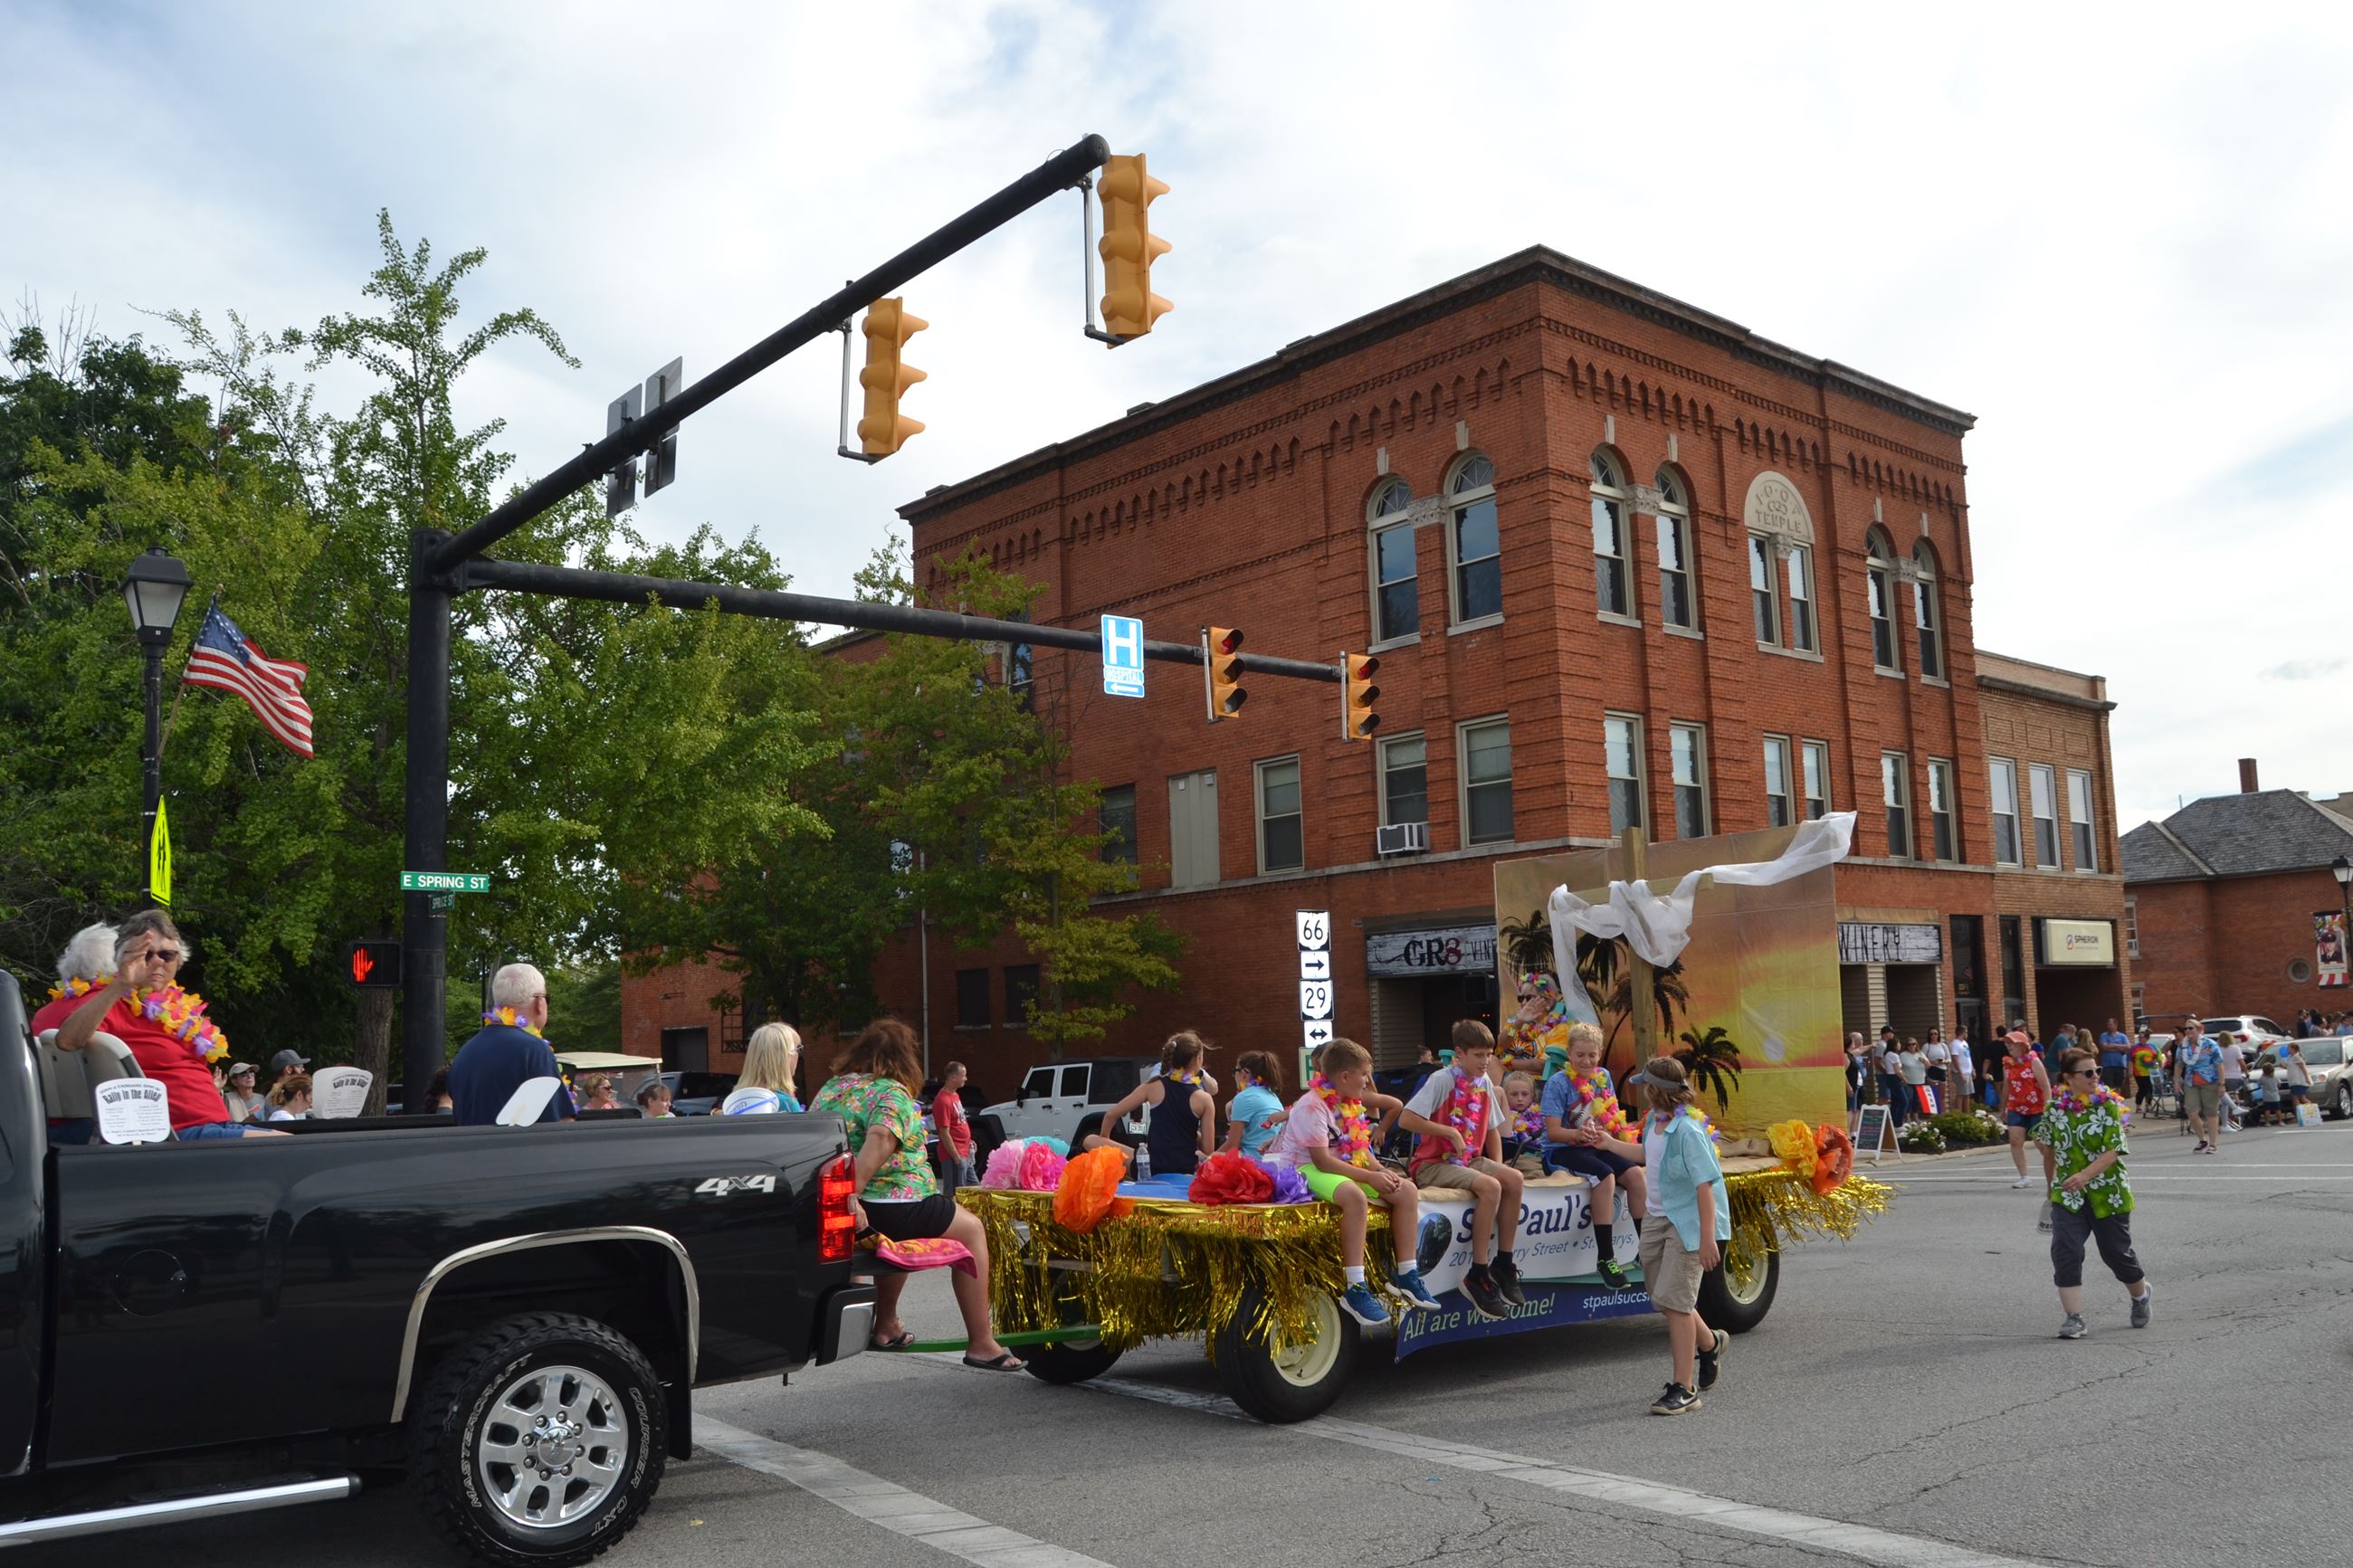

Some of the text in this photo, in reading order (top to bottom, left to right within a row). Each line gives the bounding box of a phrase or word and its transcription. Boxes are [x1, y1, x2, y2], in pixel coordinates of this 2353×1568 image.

[1755, 509, 1802, 534] TEMPLE
[1108, 619, 1138, 667] H
[403, 874, 486, 889] E SPRING ST
[1303, 919, 1323, 940] 66
[1404, 937, 1462, 966] GR8
[1837, 925, 1902, 962] WINERY
[1305, 987, 1326, 1009] 29
[130, 1088, 142, 1099] the
[1531, 1241, 1567, 1256] Street
[1581, 1235, 1595, 1250] St.
[1612, 1233, 1634, 1250] arys,
[1583, 1289, 1651, 1313] stpaulsuccs
[1404, 1311, 1427, 1343] All
[1430, 1312, 1461, 1333] are
[461, 1353, 533, 1508] MASTERCRAFT
[591, 1387, 650, 1537] COURSER CXT
